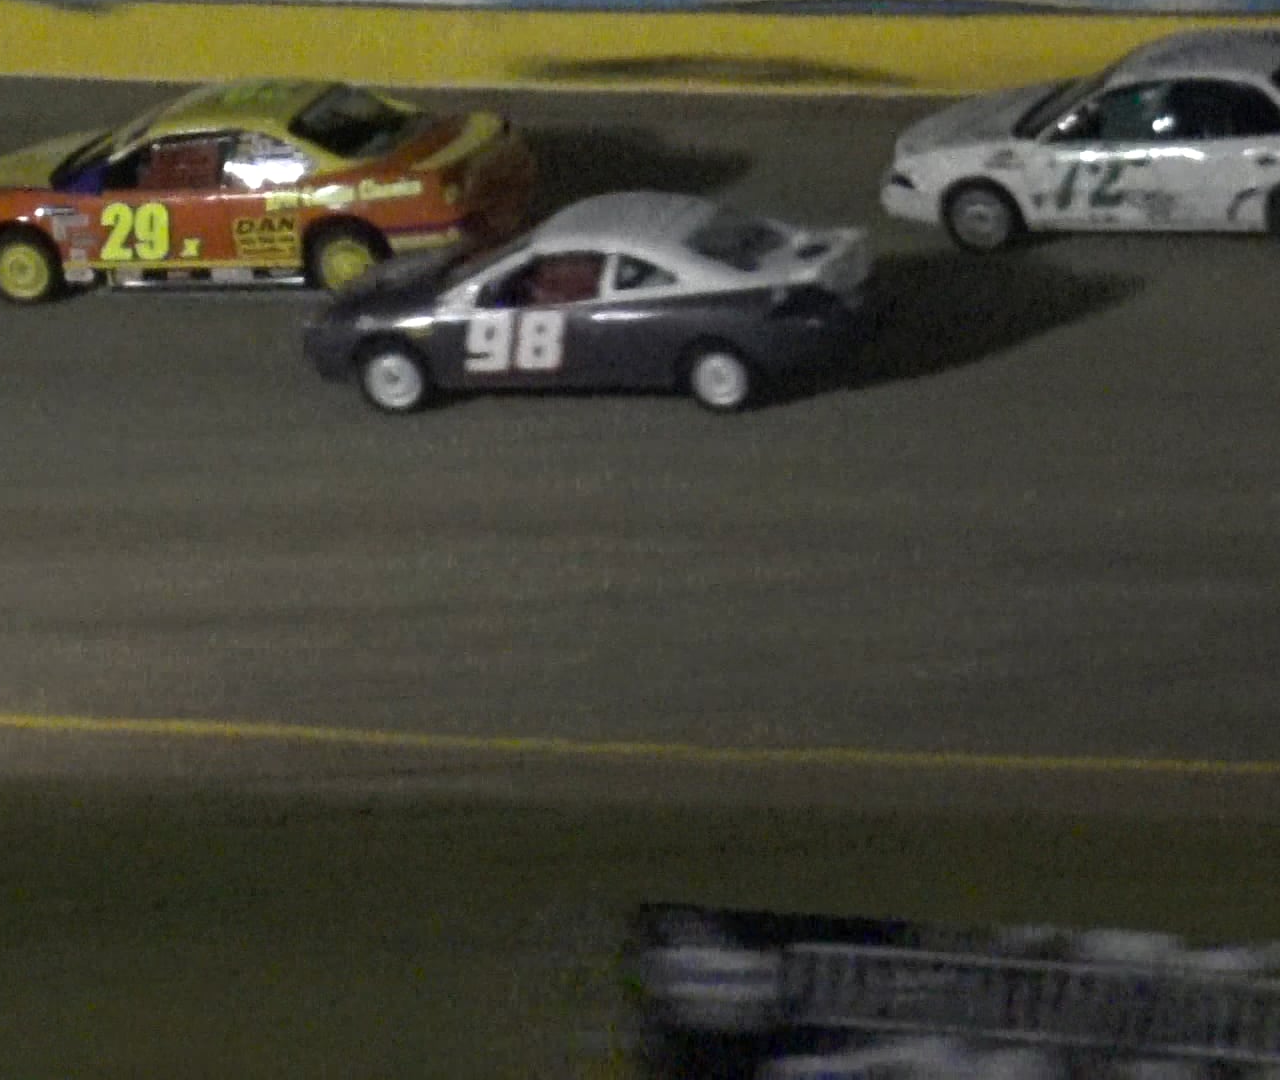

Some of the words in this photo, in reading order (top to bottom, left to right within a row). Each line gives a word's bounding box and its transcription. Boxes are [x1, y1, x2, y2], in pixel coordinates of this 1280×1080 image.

[100, 202, 170, 260] 29
[236, 217, 295, 235] DAN
[464, 309, 564, 372] 98
